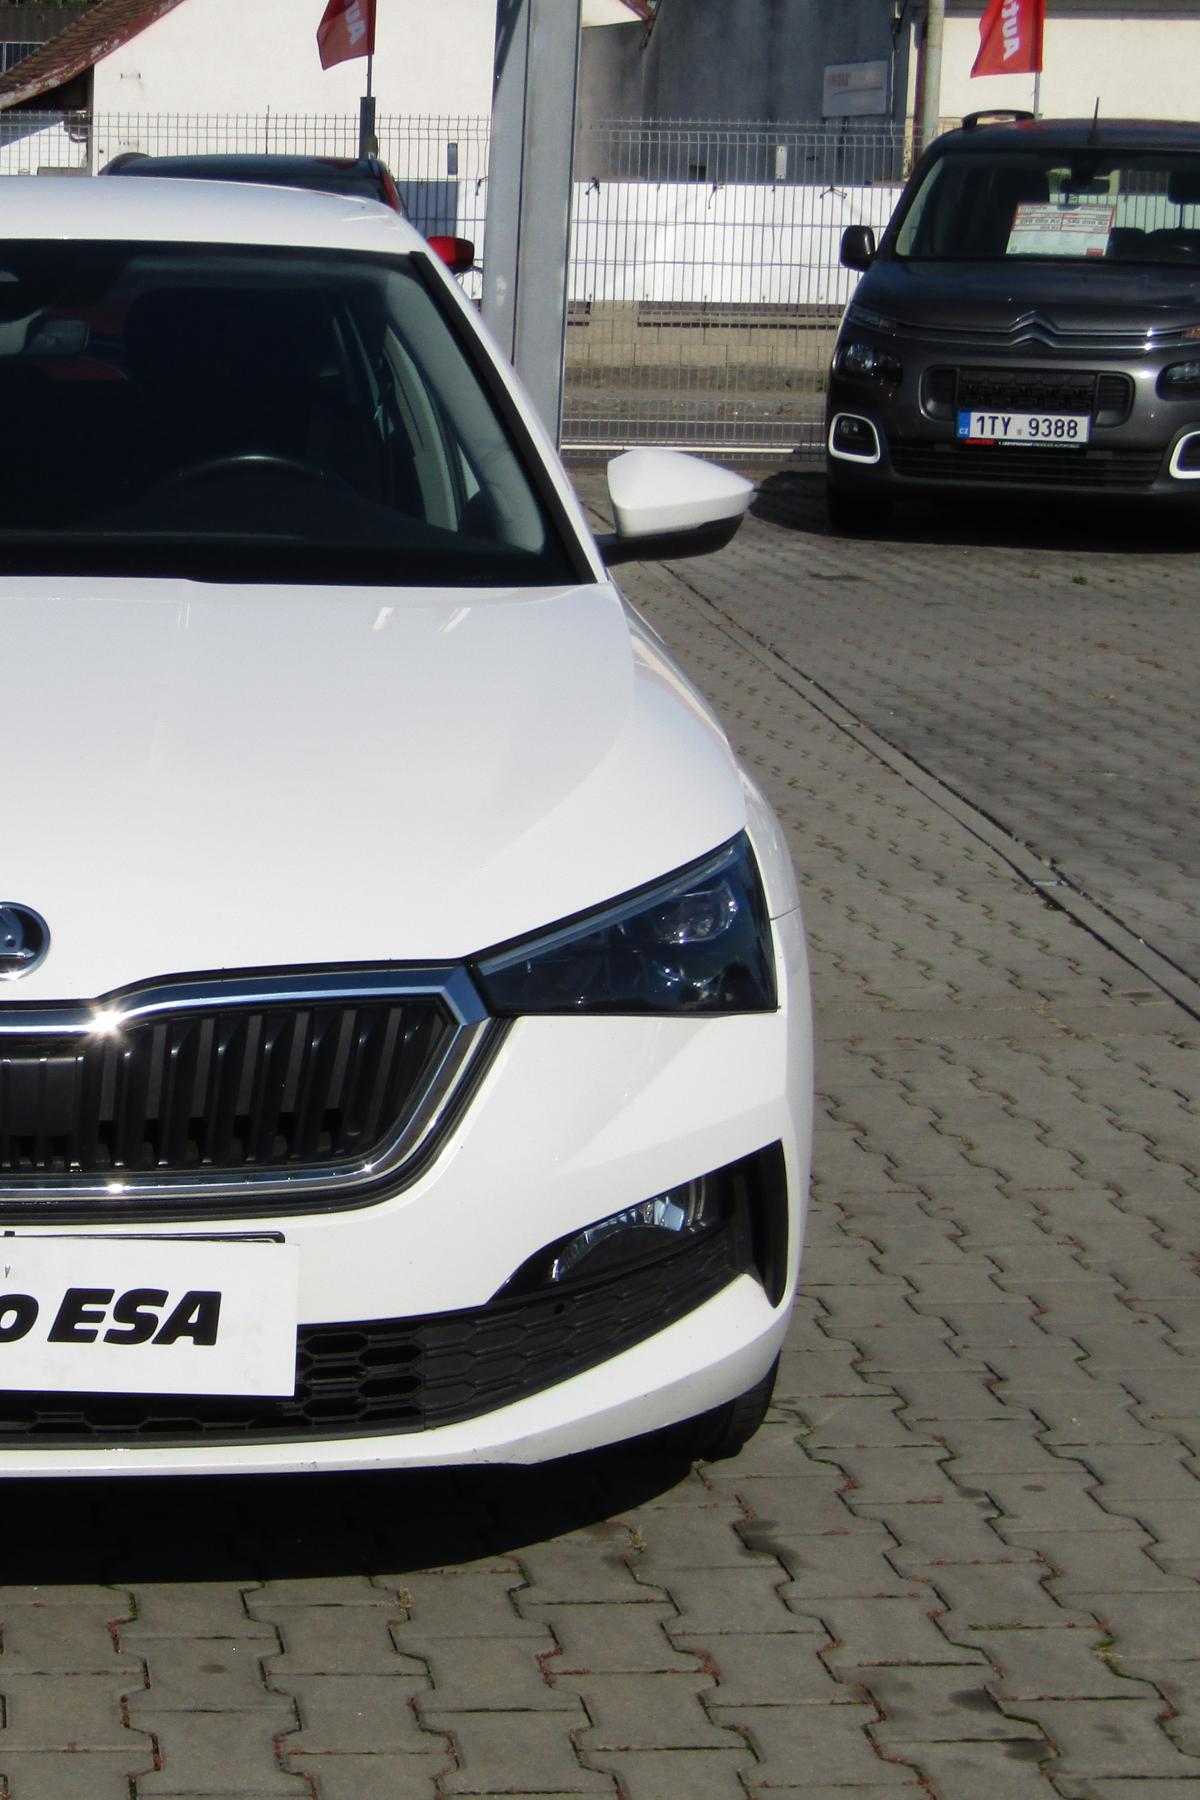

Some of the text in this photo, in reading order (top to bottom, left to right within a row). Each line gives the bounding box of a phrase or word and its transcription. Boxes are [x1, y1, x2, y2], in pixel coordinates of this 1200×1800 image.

[958, 427, 968, 435] CZ
[976, 415, 1078, 438] 1TY 9388
[47, 1287, 222, 1345] ESA
